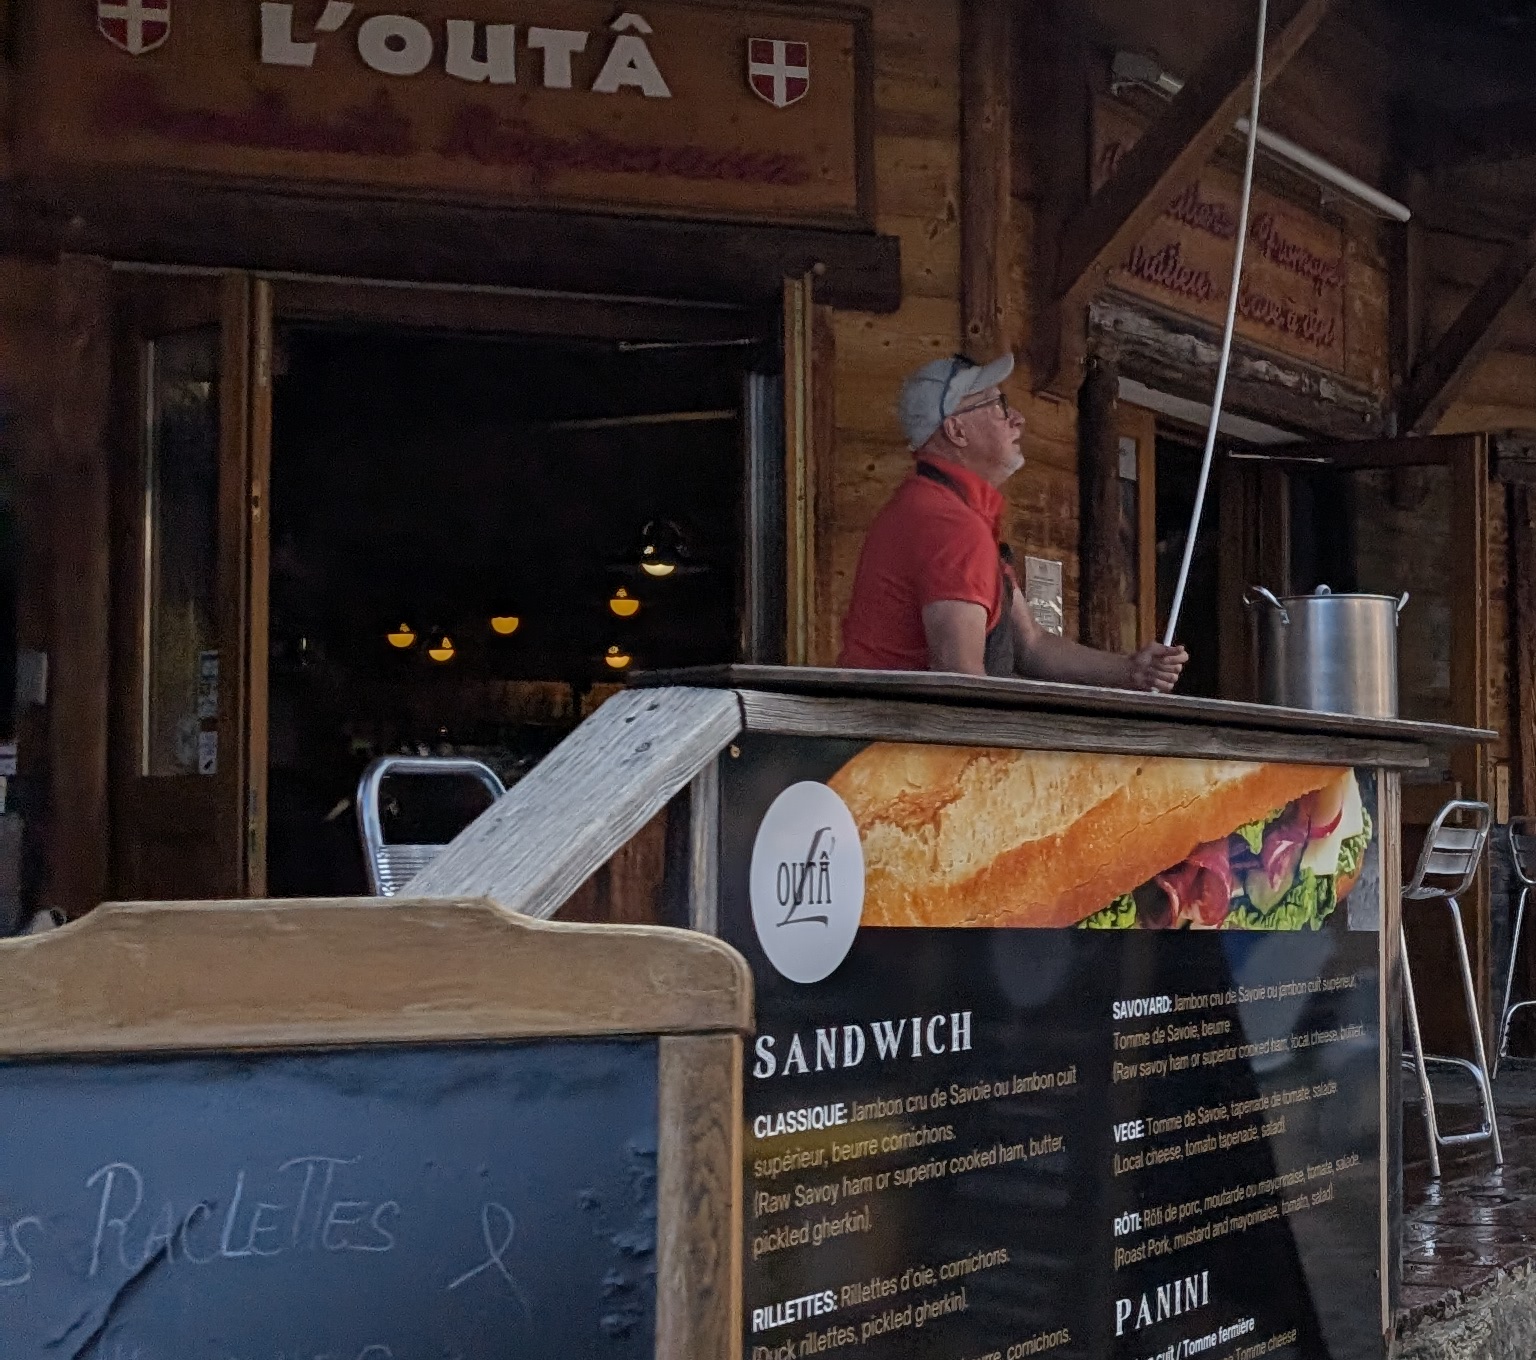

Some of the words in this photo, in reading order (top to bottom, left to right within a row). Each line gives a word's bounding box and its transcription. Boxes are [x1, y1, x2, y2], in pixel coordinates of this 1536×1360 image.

[753, 1011, 973, 1079] SANDWICH
[1115, 1271, 1209, 1337] PANINI
[1183, 1331, 1216, 1358] Tomme
[1219, 1316, 1255, 1341] fermière
